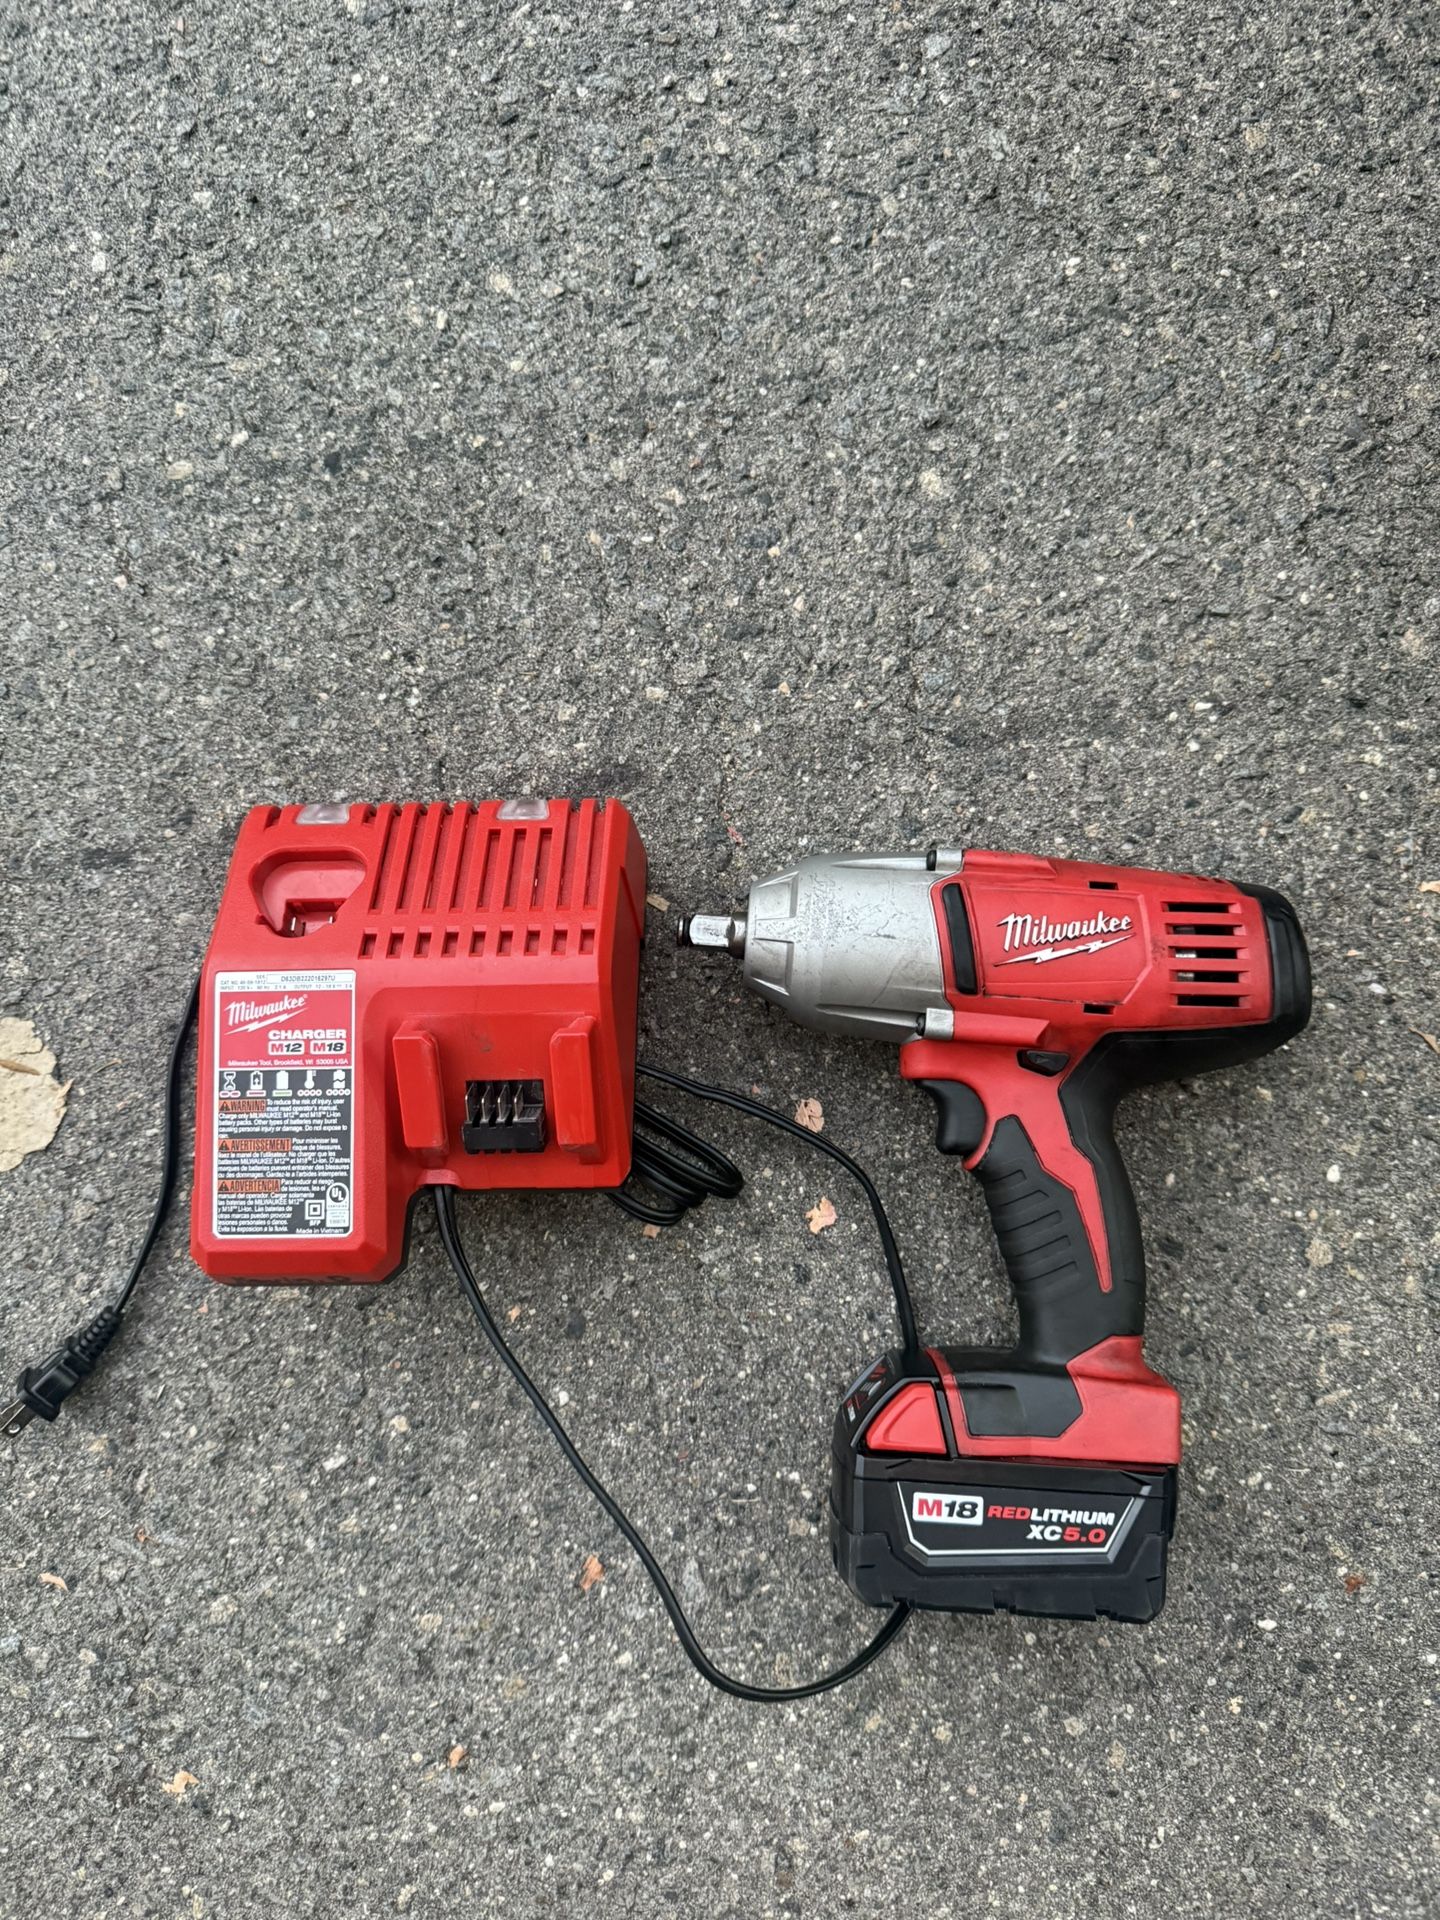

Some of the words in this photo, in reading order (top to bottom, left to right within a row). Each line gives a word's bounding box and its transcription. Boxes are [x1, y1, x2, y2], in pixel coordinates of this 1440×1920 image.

[997, 911, 1134, 952] Milwaukee
[268, 1029, 346, 1040] CHARGER
[270, 1042, 302, 1053] M12
[312, 1041, 344, 1052] M18
[231, 1100, 266, 1111] WARNING
[231, 1139, 290, 1151] AVERTISSEMENT
[231, 1180, 279, 1191] ADVERTENCIA
[331, 1187, 344, 1201] UL
[918, 1498, 979, 1519] M18
[988, 1505, 1115, 1526] REDLITHIUM
[1026, 1524, 1106, 1544] XC5.0
